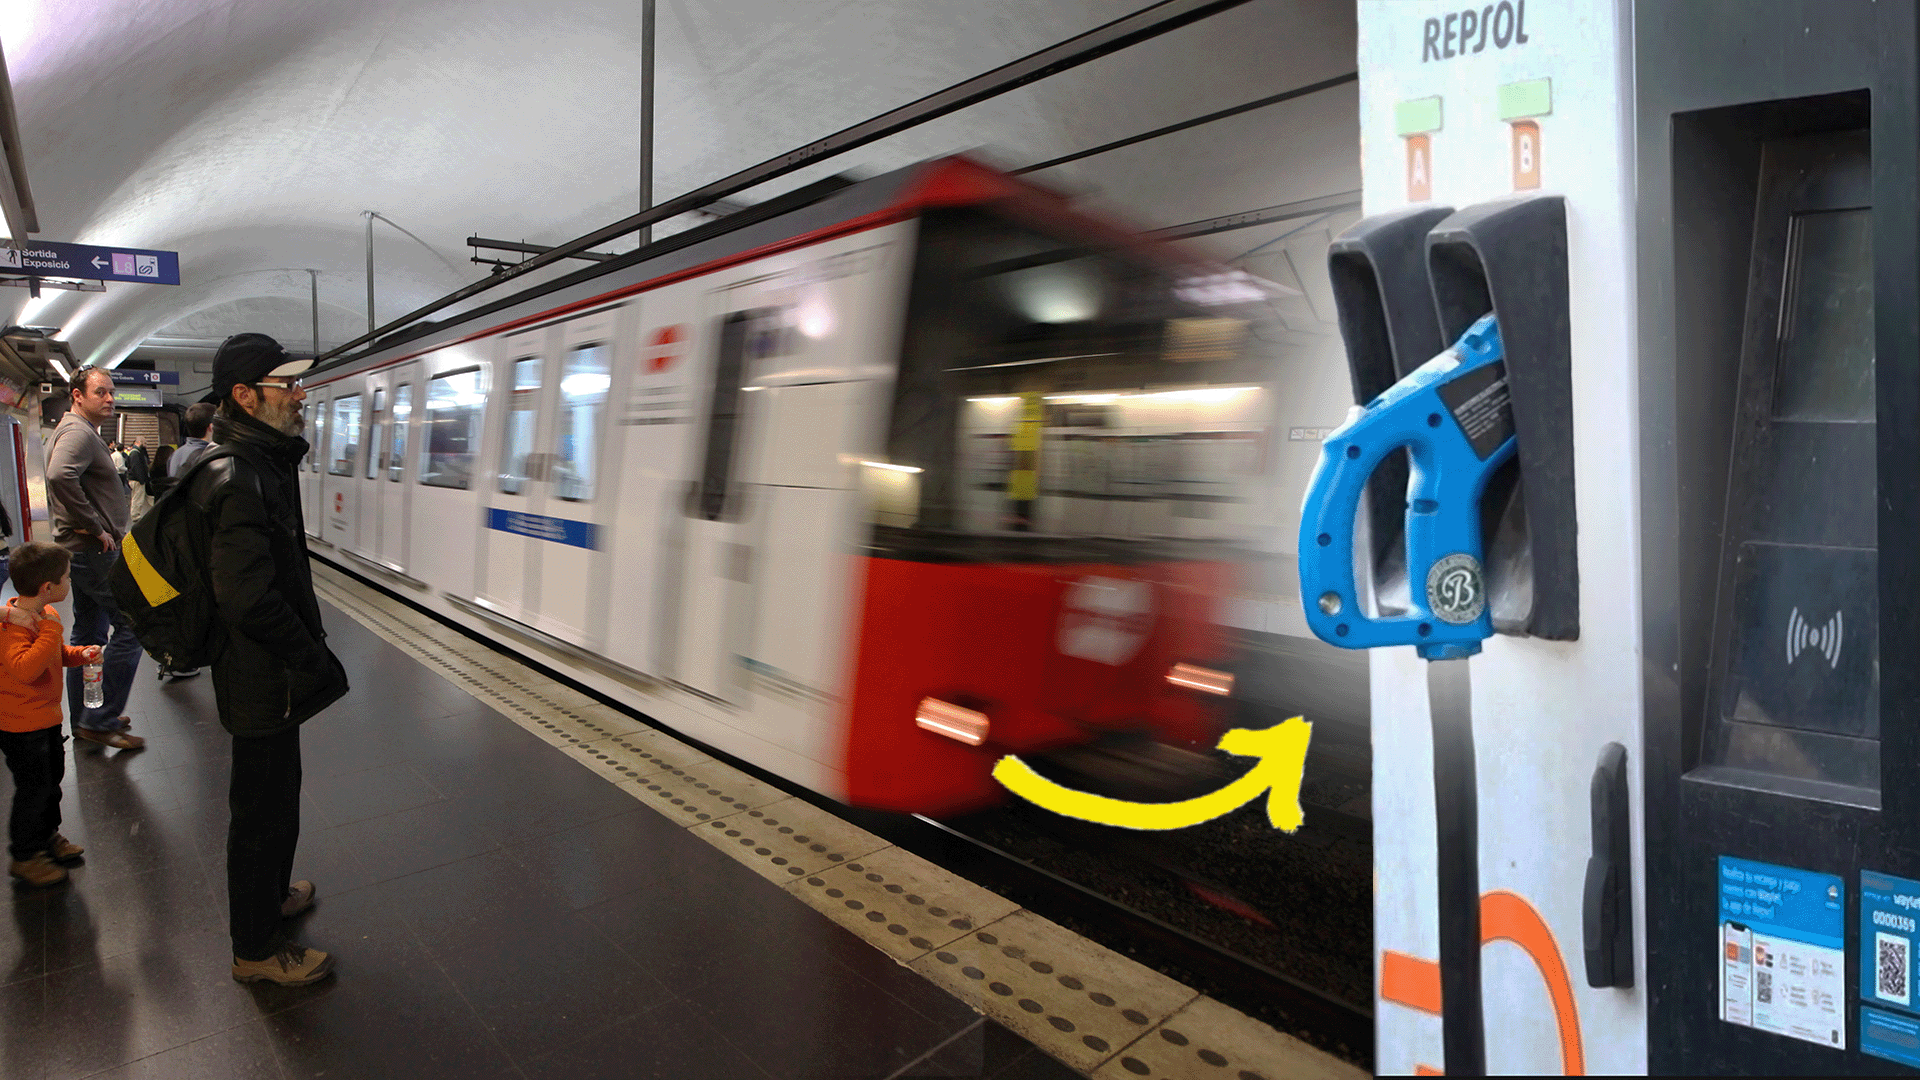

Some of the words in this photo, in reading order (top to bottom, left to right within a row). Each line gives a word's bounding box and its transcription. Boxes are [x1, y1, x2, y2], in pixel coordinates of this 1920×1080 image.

[1422, 0, 1529, 63] REPSOL
[1412, 148, 1426, 186] A
[1520, 134, 1533, 174] B
[22, 248, 57, 258] Sortida
[23, 258, 70, 269] Exposició
